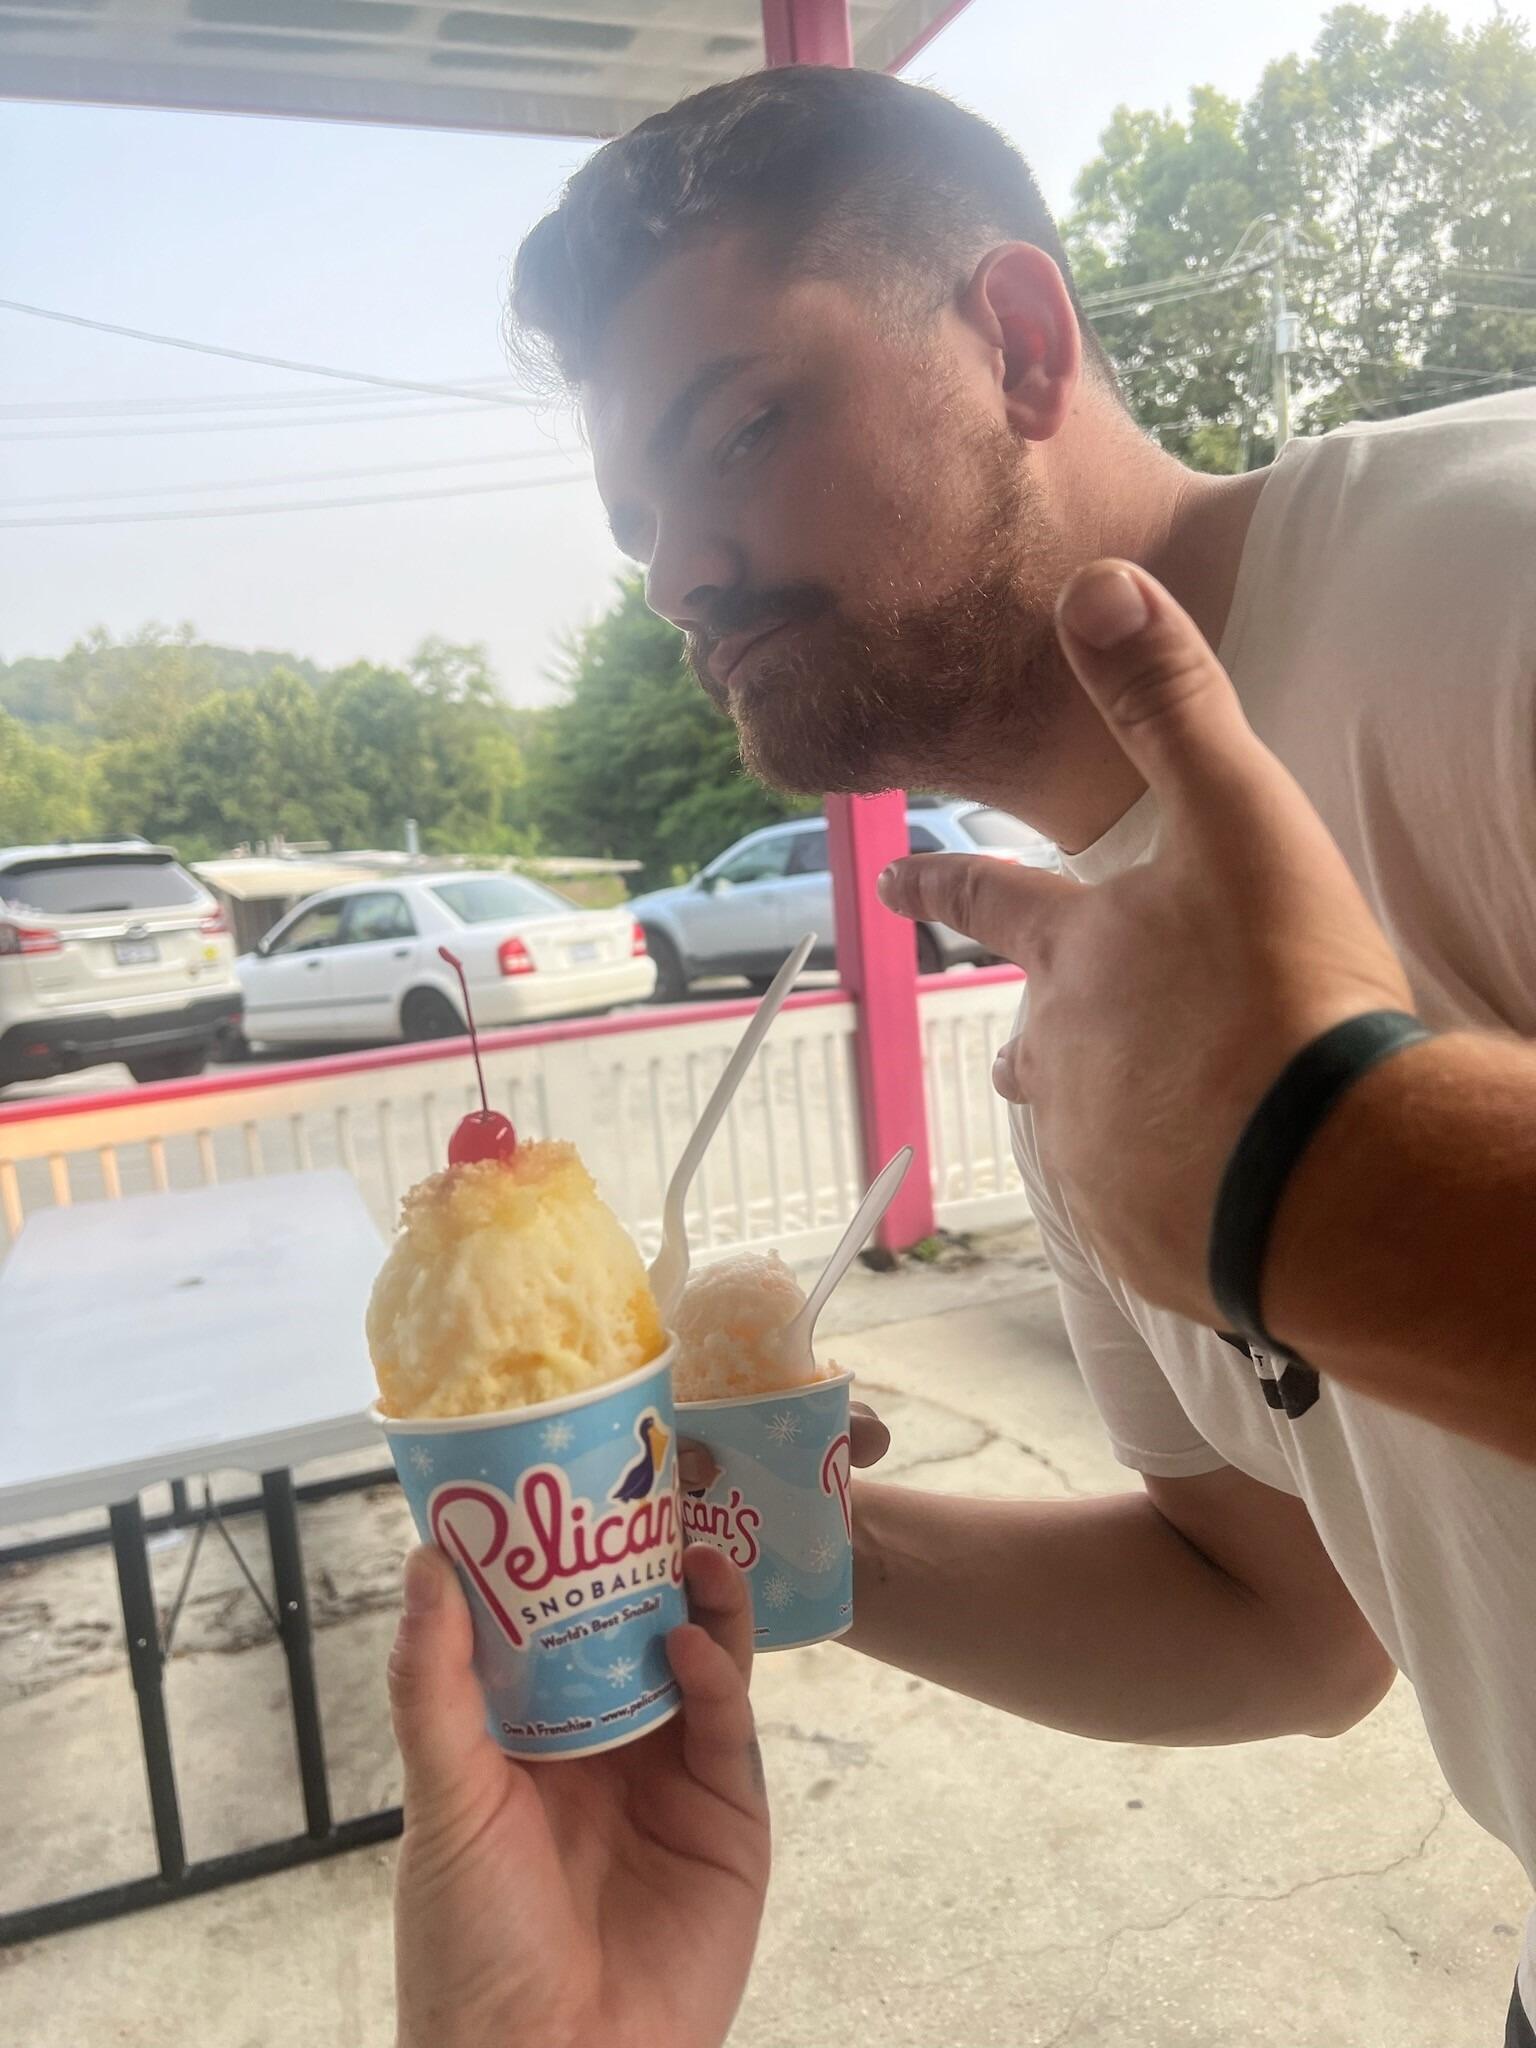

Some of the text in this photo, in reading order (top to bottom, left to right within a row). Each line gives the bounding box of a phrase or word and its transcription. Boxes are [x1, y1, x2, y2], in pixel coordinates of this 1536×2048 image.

[432, 1462, 682, 1646] Pelican
[521, 1558, 666, 1624] SNOBALLS
[540, 1626, 588, 1649] World's
[591, 1615, 619, 1633] Best
[527, 1725, 536, 1736] A
